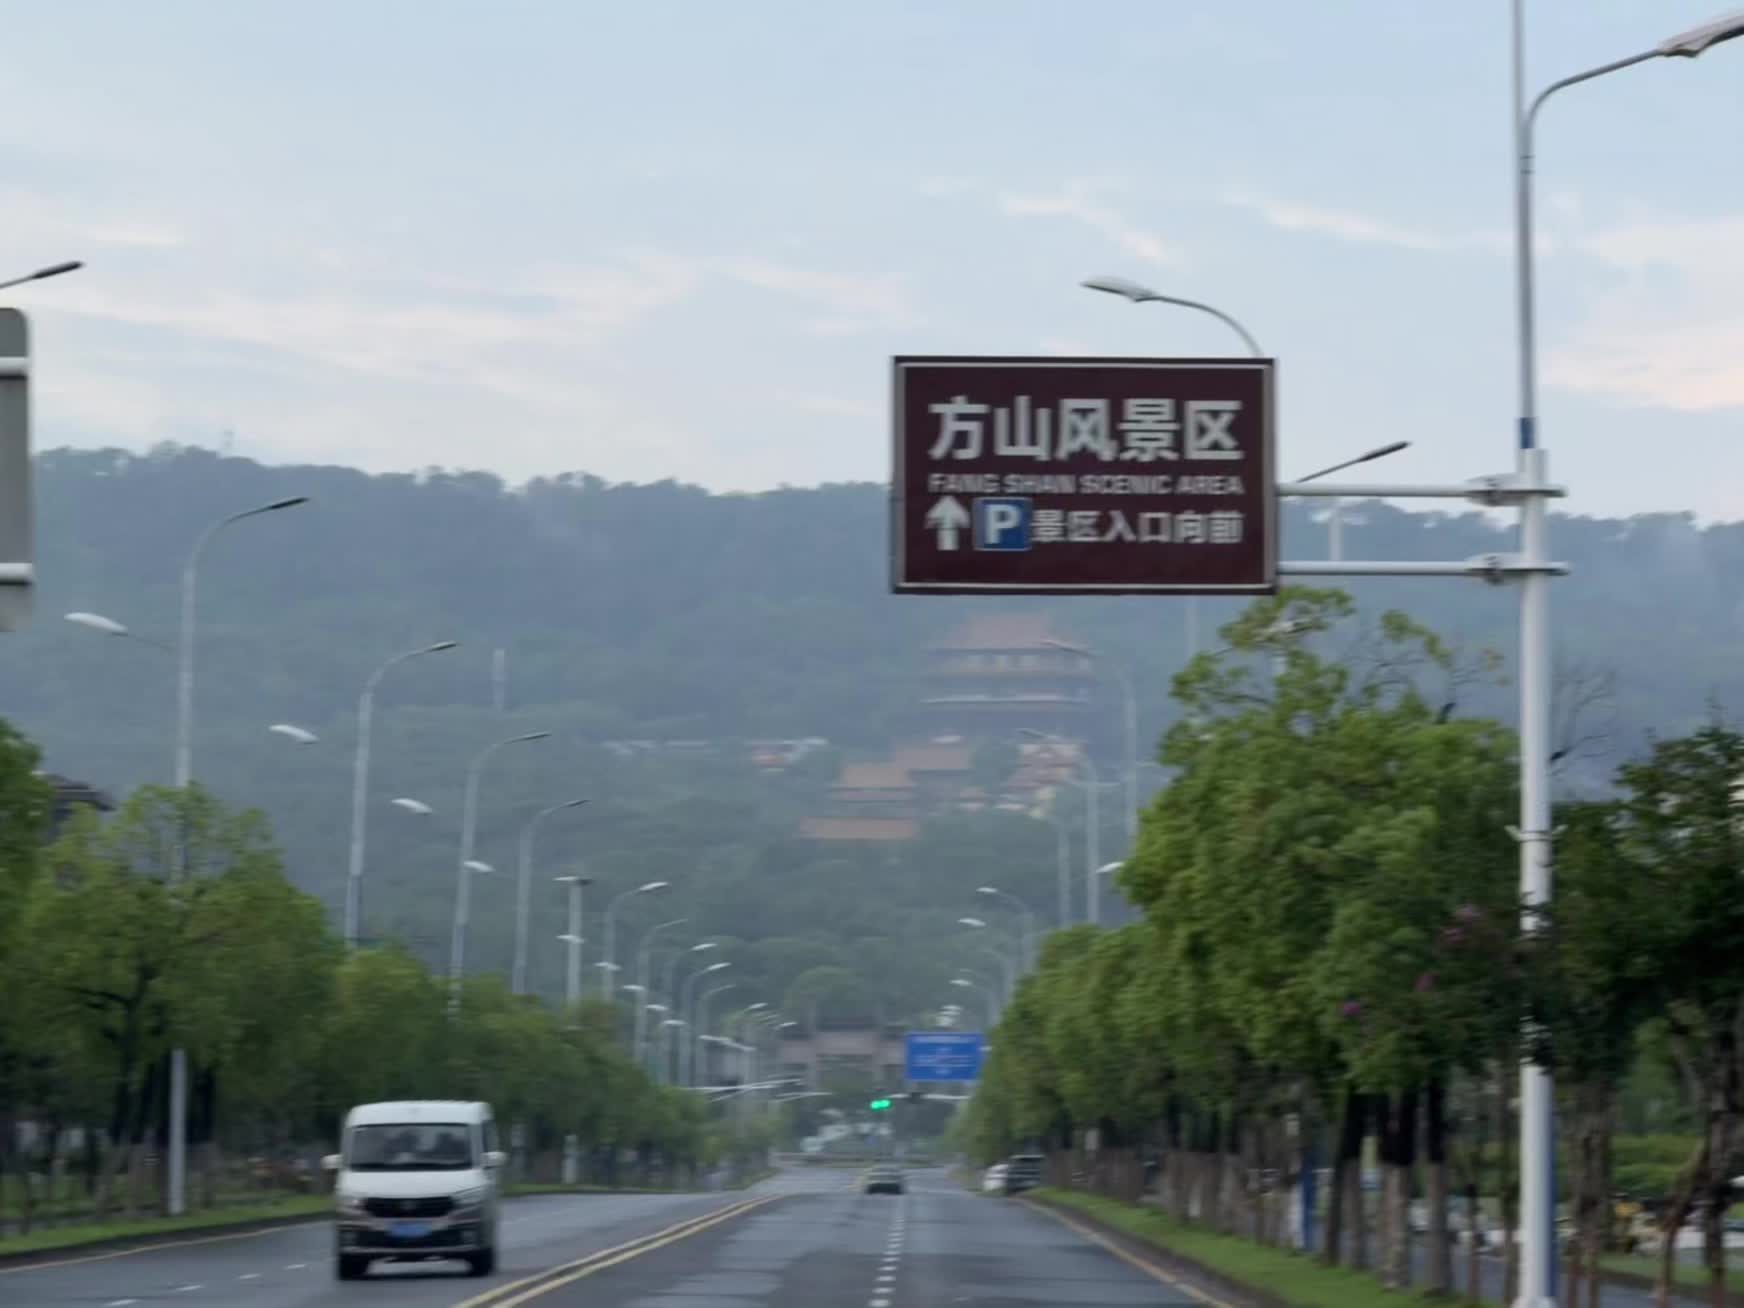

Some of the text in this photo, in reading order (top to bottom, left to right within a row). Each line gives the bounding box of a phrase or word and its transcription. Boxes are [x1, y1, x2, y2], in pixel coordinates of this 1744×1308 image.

[928, 396, 1245, 462] 方山风景区
[928, 474, 1245, 494] FANG SHAN SCENIC AREA
[984, 504, 1244, 545] P 景区入口向前
